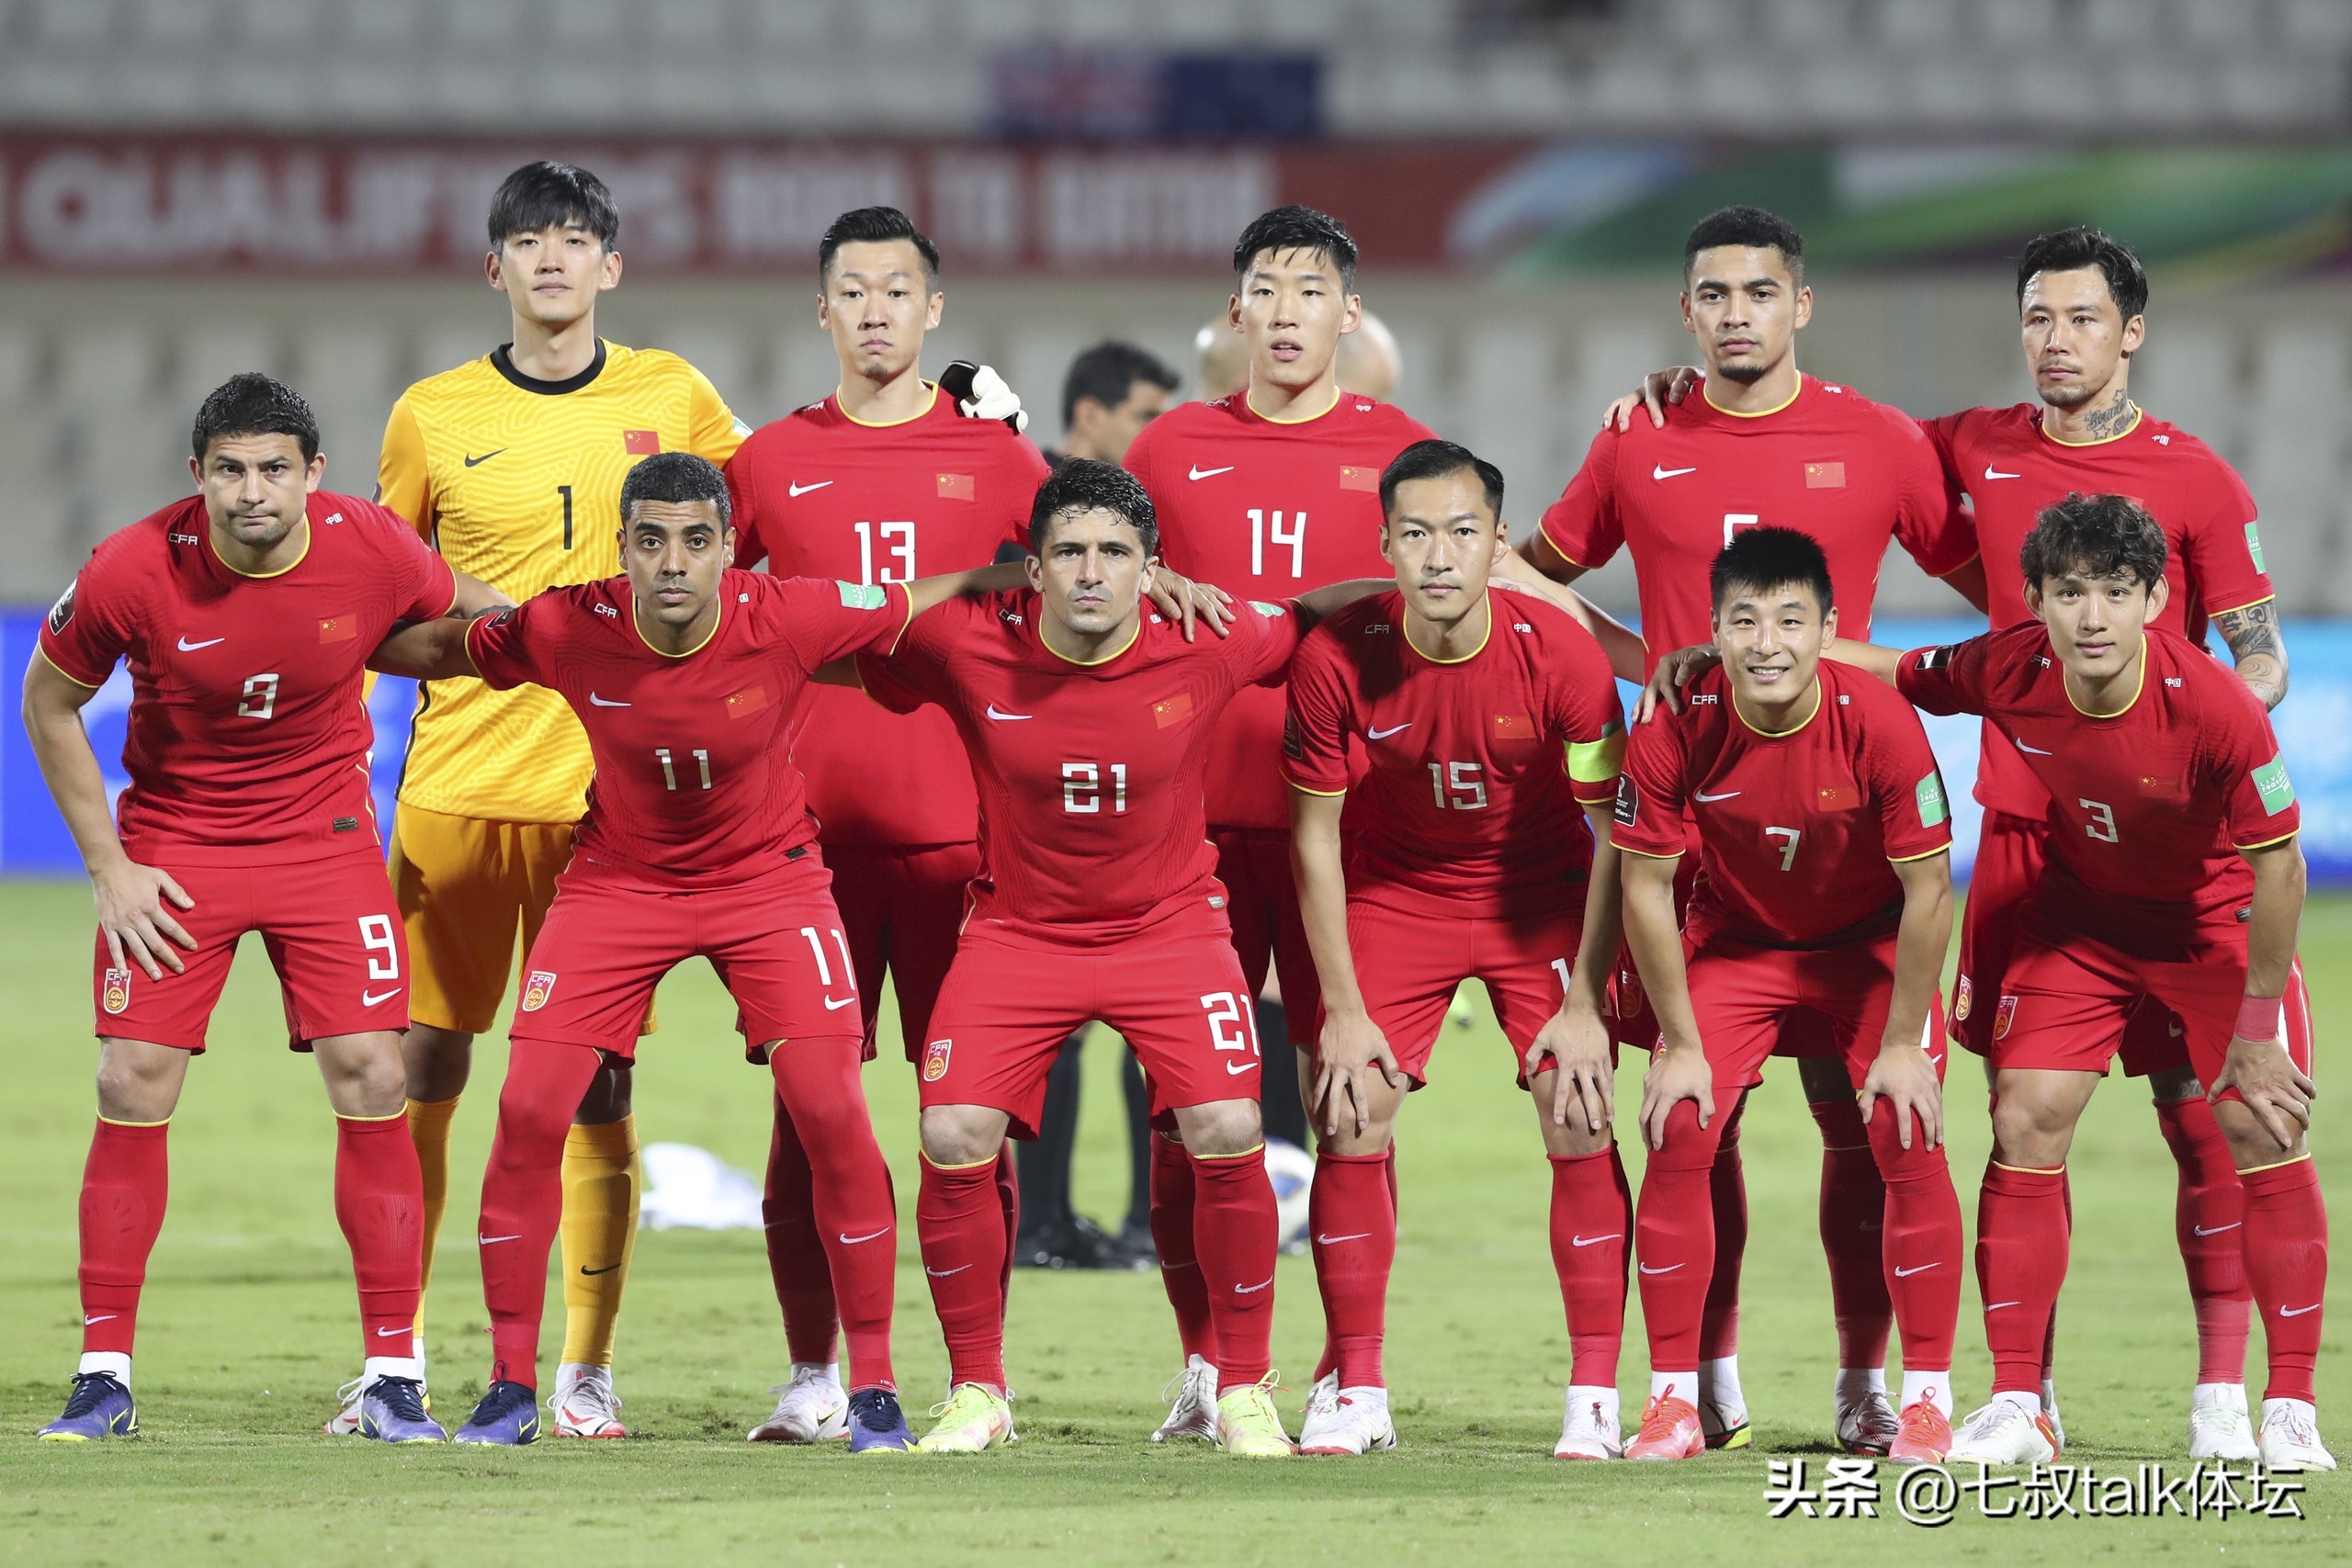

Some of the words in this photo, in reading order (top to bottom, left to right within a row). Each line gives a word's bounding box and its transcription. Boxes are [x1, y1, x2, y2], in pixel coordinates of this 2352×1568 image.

[168, 533, 198, 546] CFA
[557, 485, 571, 550] 1
[854, 521, 915, 586] 13
[1247, 509, 1306, 578] 14
[594, 603, 617, 619] CFA
[999, 608, 1023, 626] CFA
[1365, 624, 1390, 634] CFA
[237, 673, 279, 720] 9
[1692, 694, 1718, 705] CFA
[655, 748, 713, 791] 11
[1061, 761, 1127, 814] 21
[1427, 761, 1488, 810] 15
[2078, 798, 2120, 844] 3
[1765, 827, 1801, 872] 7
[357, 913, 400, 981] 9
[800, 926, 856, 991] 11
[531, 975, 552, 985] CFA
[1200, 991, 1261, 1057] 21
